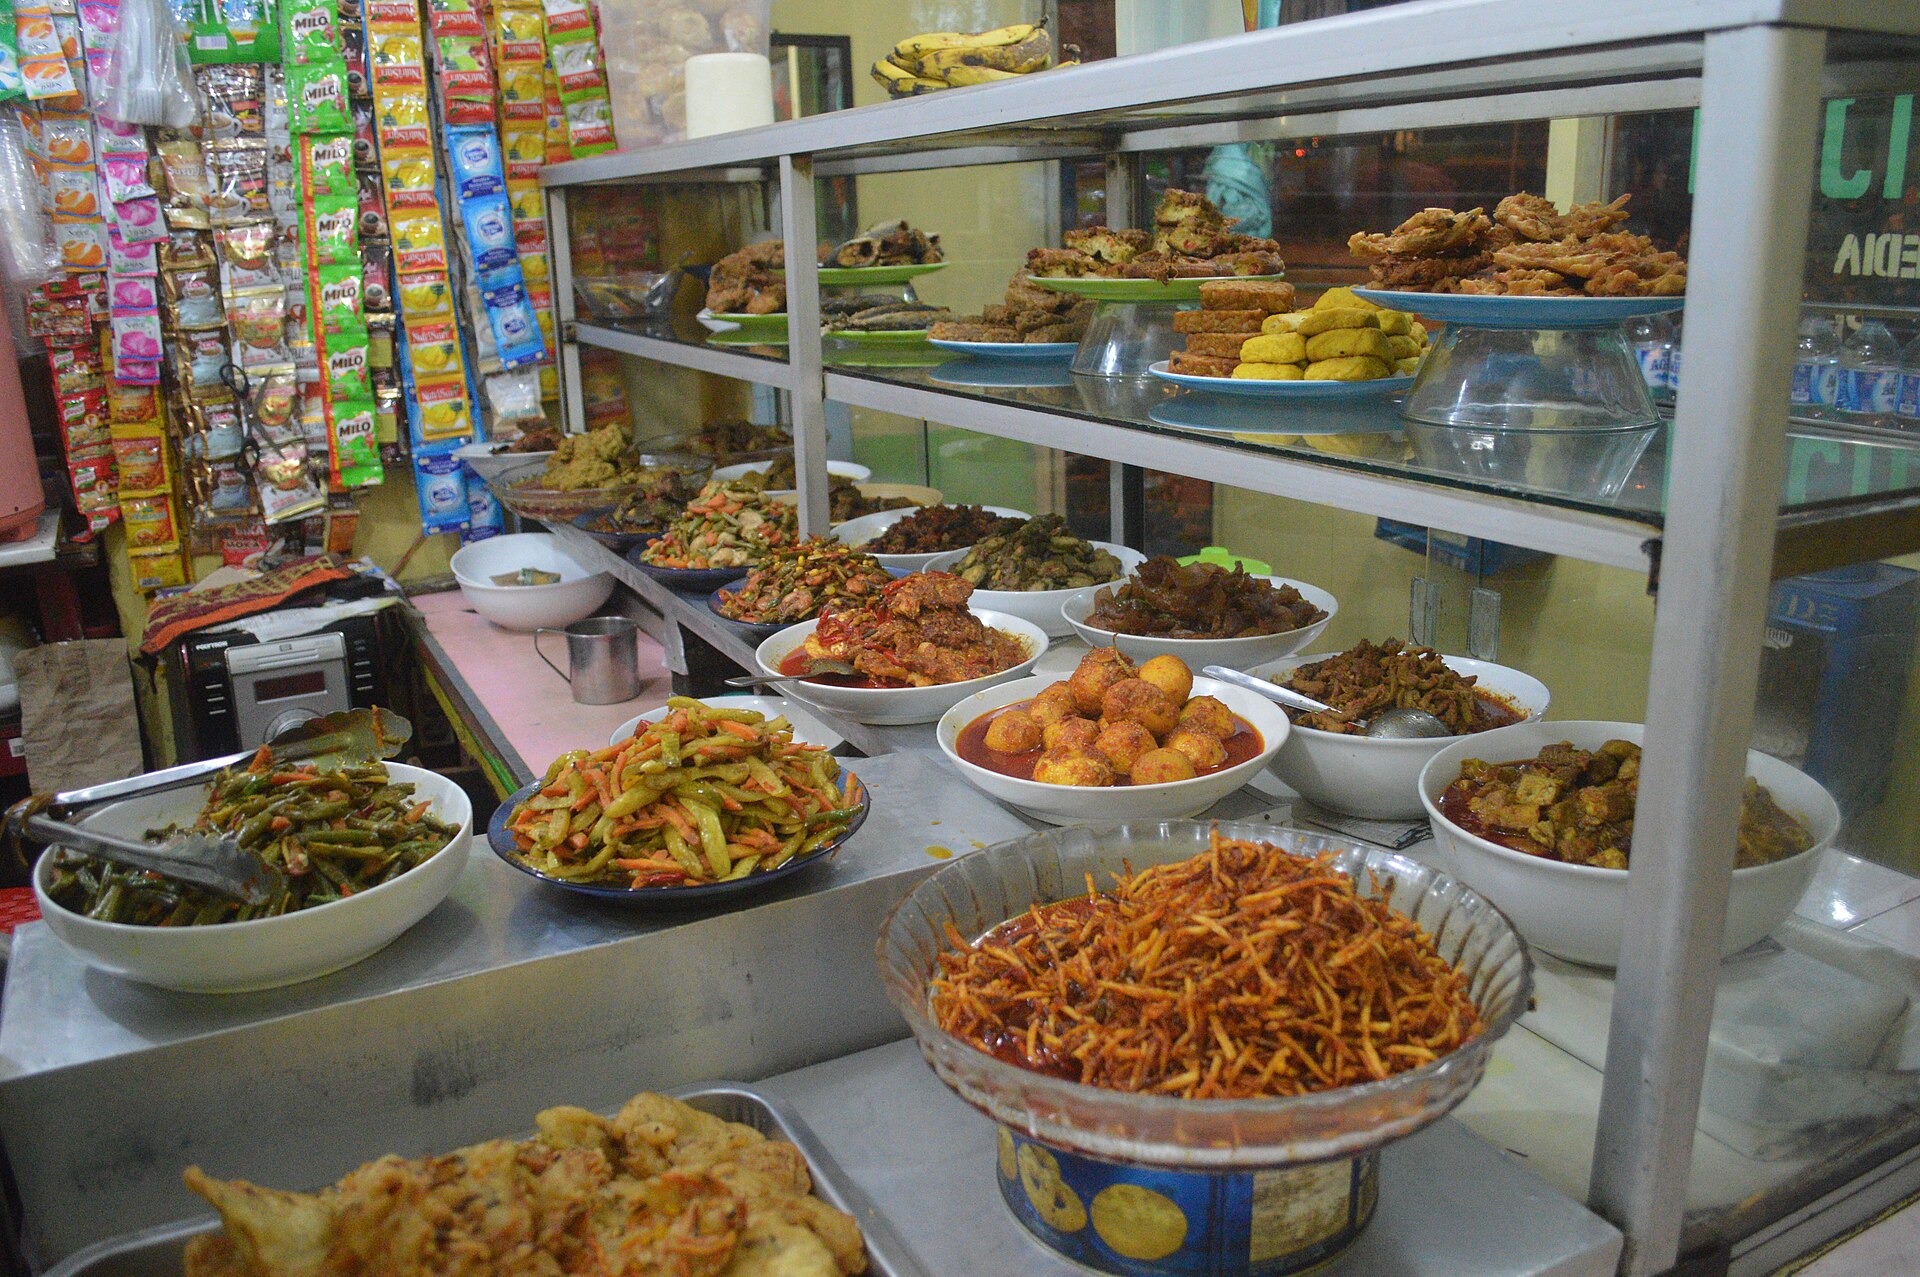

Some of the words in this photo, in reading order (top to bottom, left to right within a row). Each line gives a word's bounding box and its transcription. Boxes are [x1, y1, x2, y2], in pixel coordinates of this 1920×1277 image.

[295, 16, 328, 30] MILO
[380, 67, 420, 78] NutriSari
[450, 72, 488, 83] NutriSari
[387, 130, 426, 141] NutriSari
[314, 148, 347, 161] MILO
[394, 193, 432, 204] NutriSari
[403, 252, 441, 264] NutriSari
[324, 286, 356, 301] MILO
[411, 329, 450, 343] NutriSari
[331, 355, 363, 370] MILO
[420, 388, 460, 401] NutriSari
[339, 421, 371, 437] MILO
